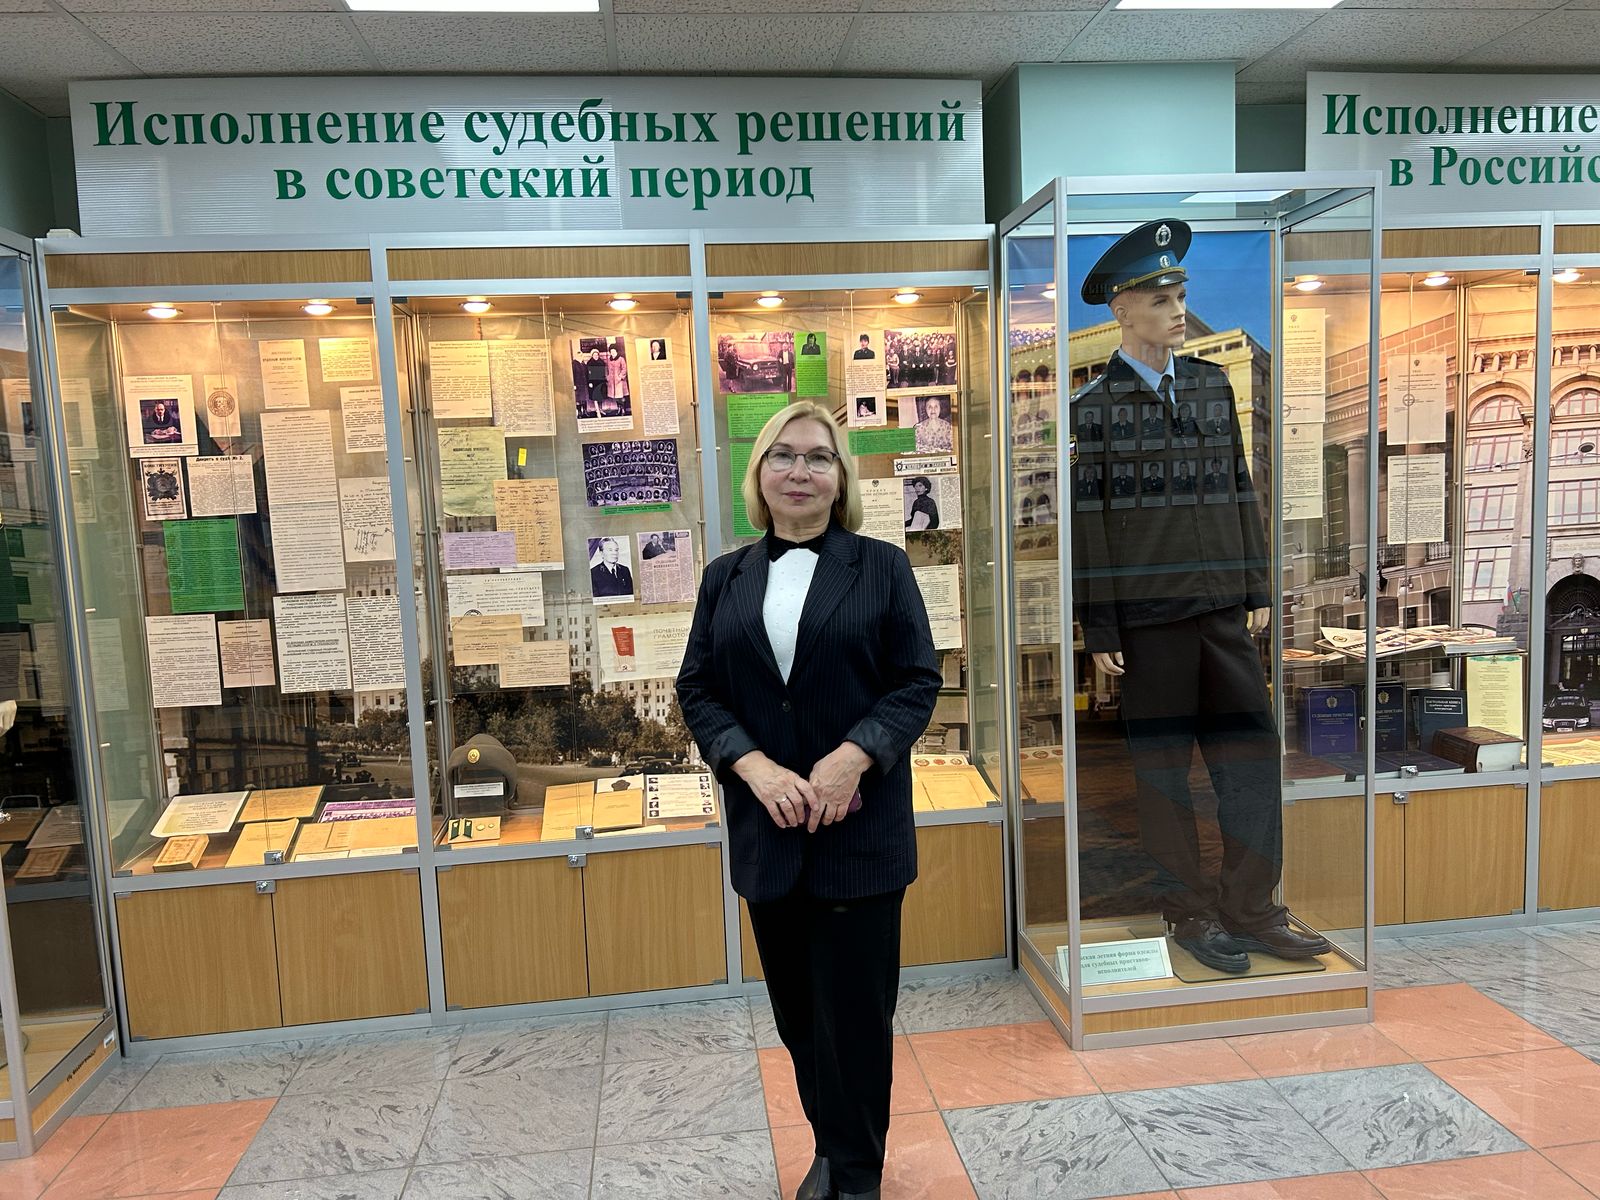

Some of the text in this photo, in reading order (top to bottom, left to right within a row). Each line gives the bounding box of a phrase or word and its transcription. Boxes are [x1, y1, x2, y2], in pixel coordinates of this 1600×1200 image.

[90, 98, 966, 155] Исполнение судебных решений
[1322, 94, 1598, 135] Исполнение
[273, 155, 815, 210] в советский период
[1389, 144, 1600, 186] в Российс
